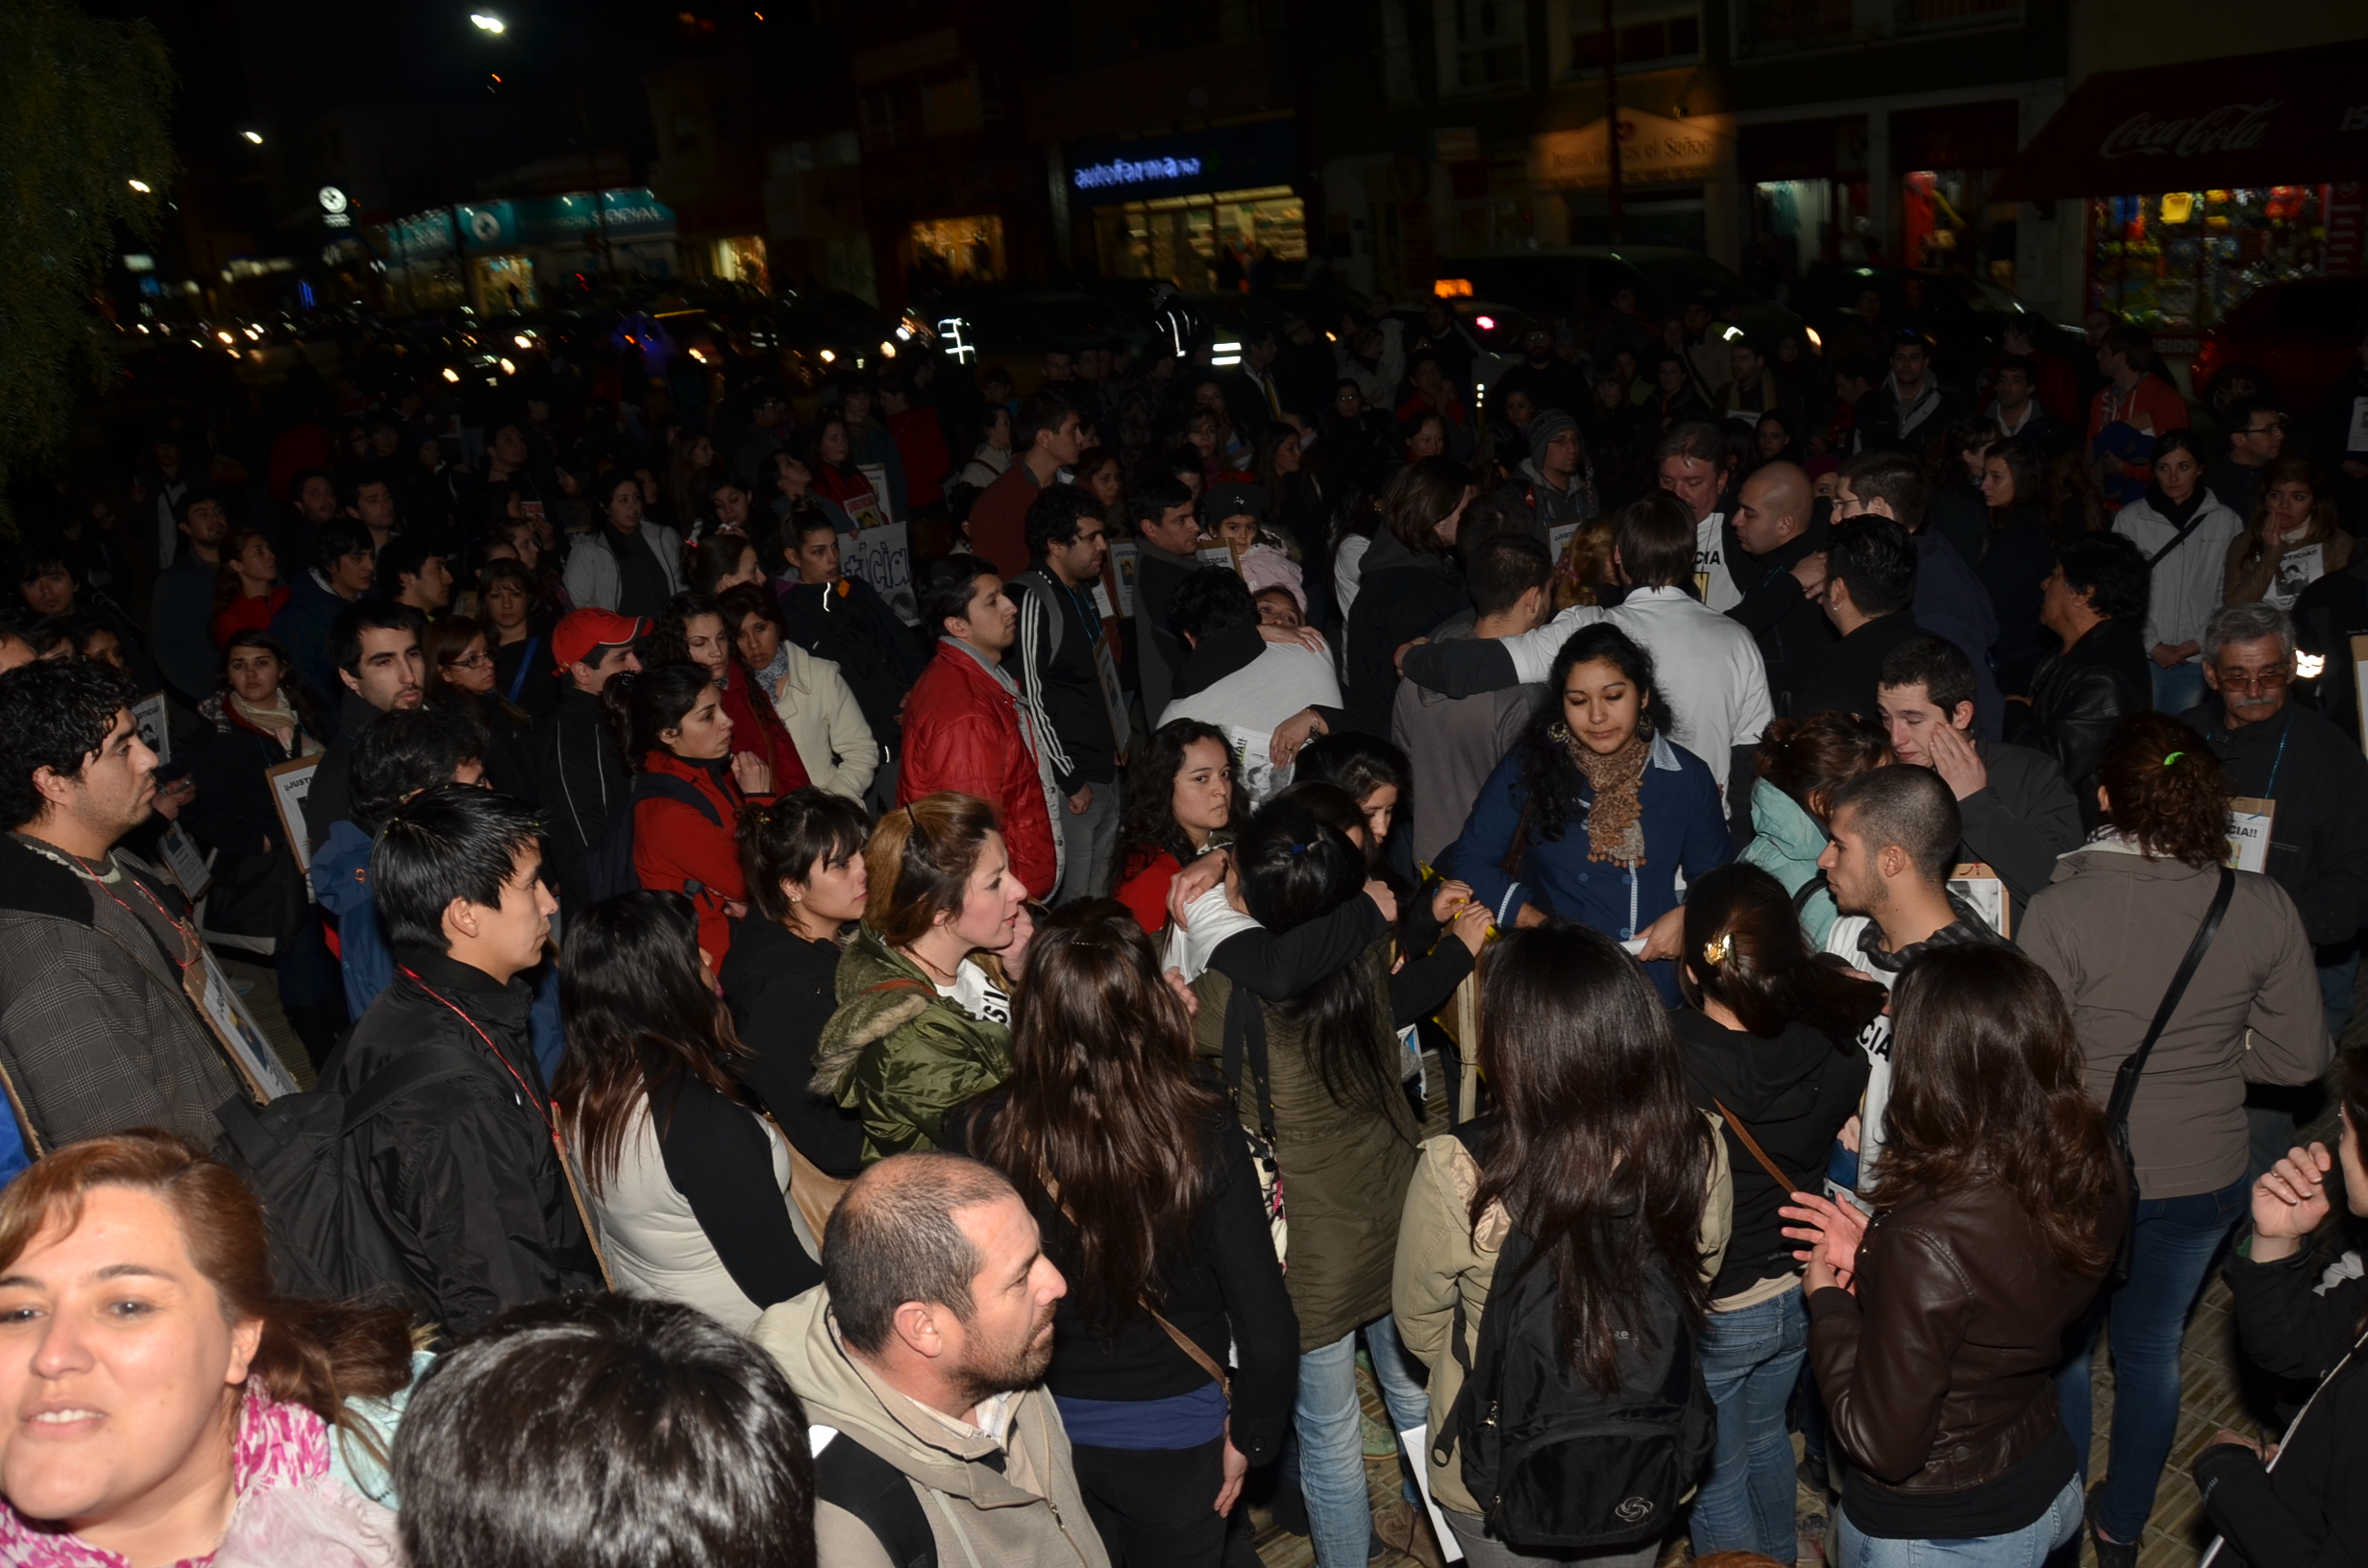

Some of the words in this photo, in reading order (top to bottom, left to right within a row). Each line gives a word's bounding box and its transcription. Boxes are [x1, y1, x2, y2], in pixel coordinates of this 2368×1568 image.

[2098, 98, 2286, 159] Coca-Cola
[840, 541, 910, 595] ticia
[284, 776, 312, 792] ¡¡JUST
